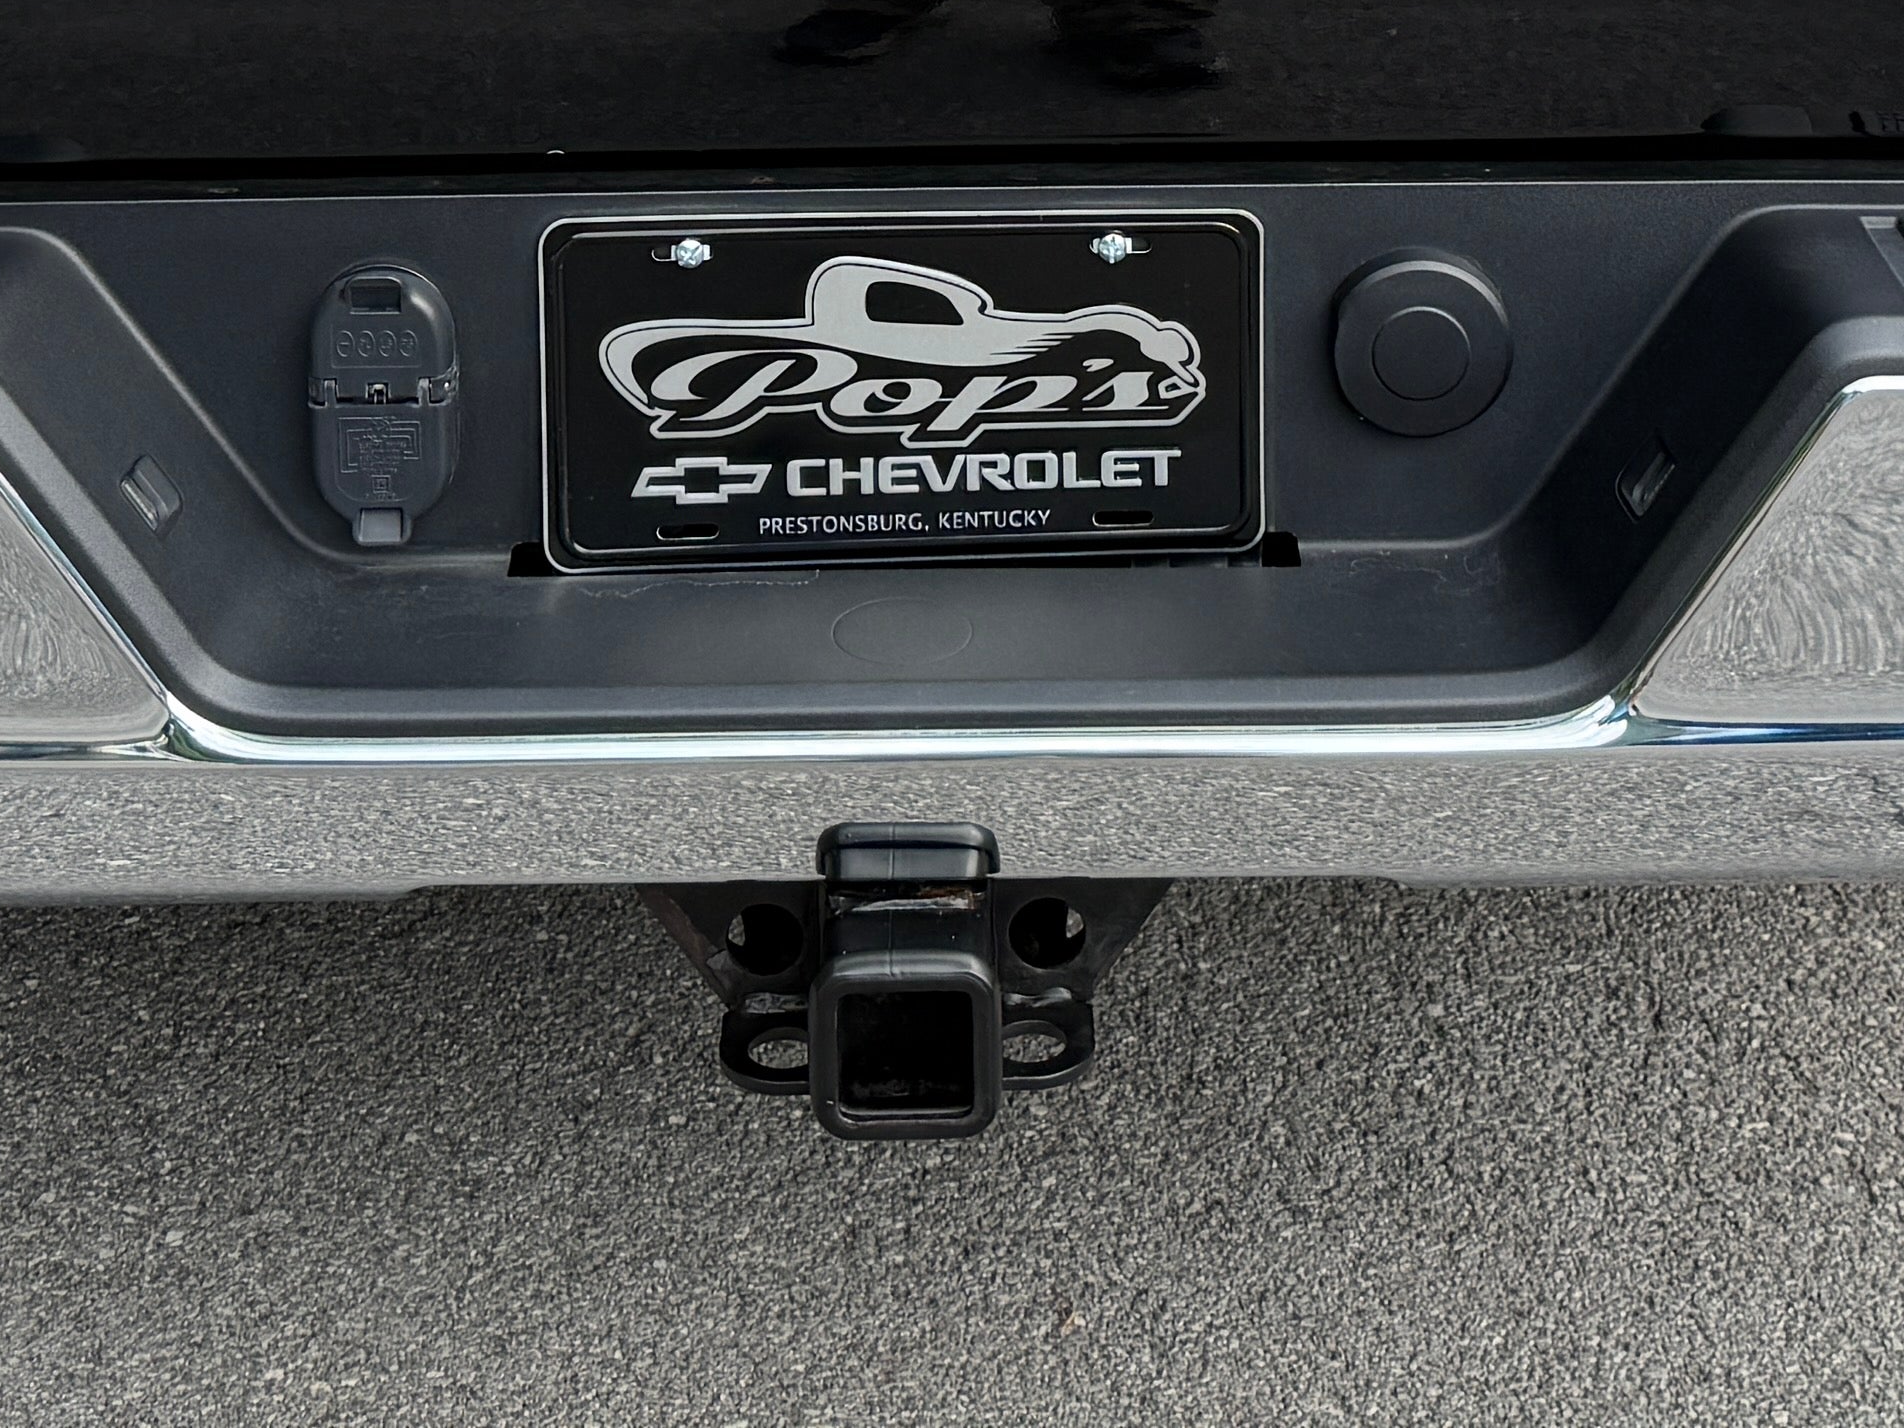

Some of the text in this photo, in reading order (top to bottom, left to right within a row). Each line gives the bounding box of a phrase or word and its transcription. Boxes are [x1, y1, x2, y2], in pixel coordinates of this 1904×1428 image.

[650, 348, 1170, 431] Pop's
[786, 449, 1182, 497] CHEVROLET
[758, 508, 1052, 537] PRESTONSBURG, KENTUCKY
